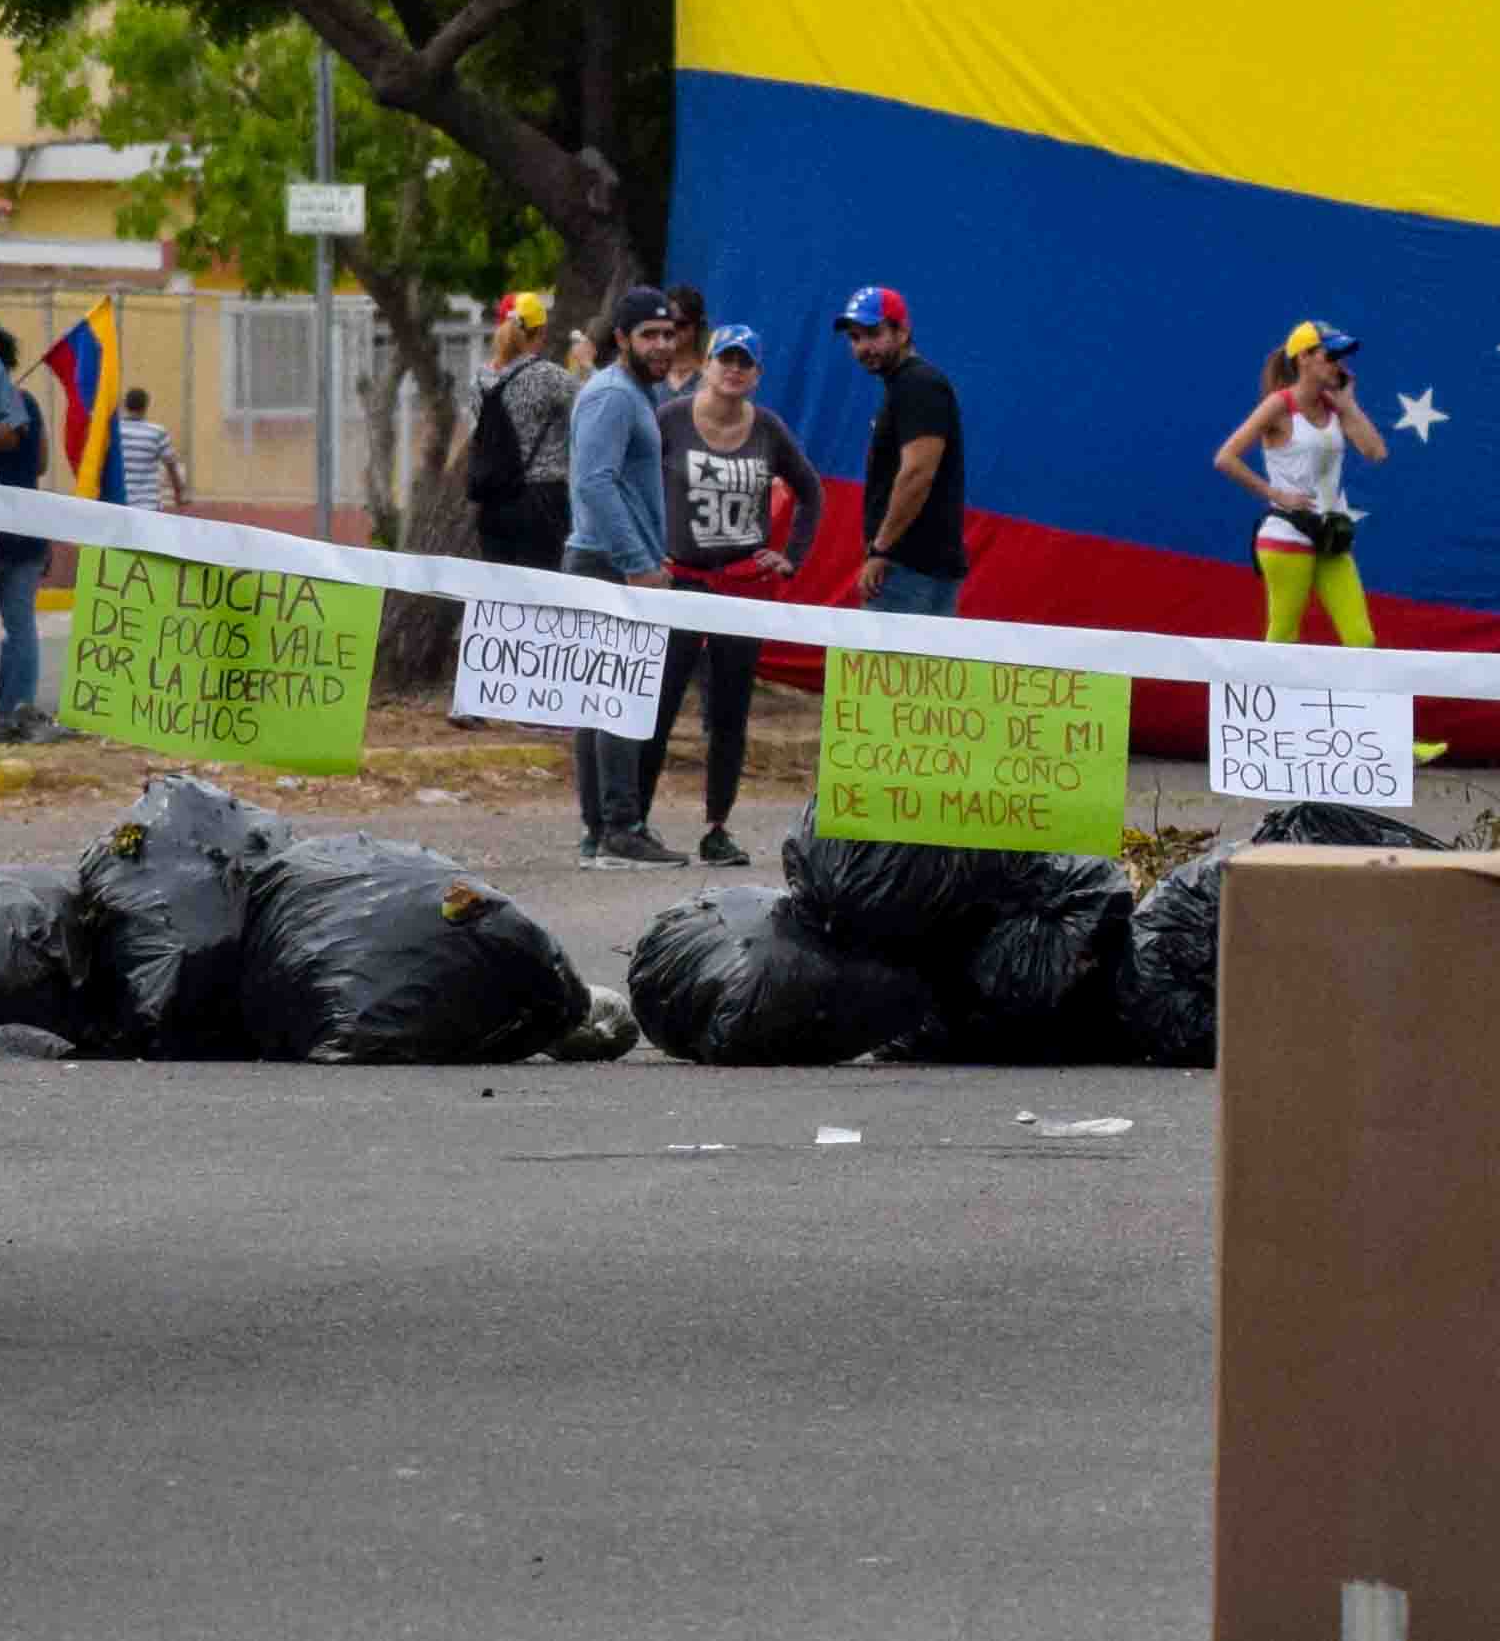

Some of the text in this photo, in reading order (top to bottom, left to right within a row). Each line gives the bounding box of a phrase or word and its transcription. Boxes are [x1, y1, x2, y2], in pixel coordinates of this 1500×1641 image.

[95, 549, 325, 623] LA LUCHA
[92, 598, 357, 671] DE POCOS VALE
[474, 599, 667, 657] NO QUEREMOS
[76, 638, 346, 708] POR LA LIBERTAD
[463, 632, 661, 698] CONSTITUYENTE
[840, 654, 1093, 711] MADURO DESDE
[72, 680, 259, 745] DE MUCHOS
[479, 680, 623, 719] NO NO NO
[835, 699, 1105, 755] EL FONDO DE MI
[1223, 681, 1367, 728] NO +
[1221, 724, 1384, 761] PRESOS
[993, 753, 1083, 792] COÑO
[1223, 757, 1398, 797] POLITICOS
[832, 783, 1052, 832] DE TU MADRE
